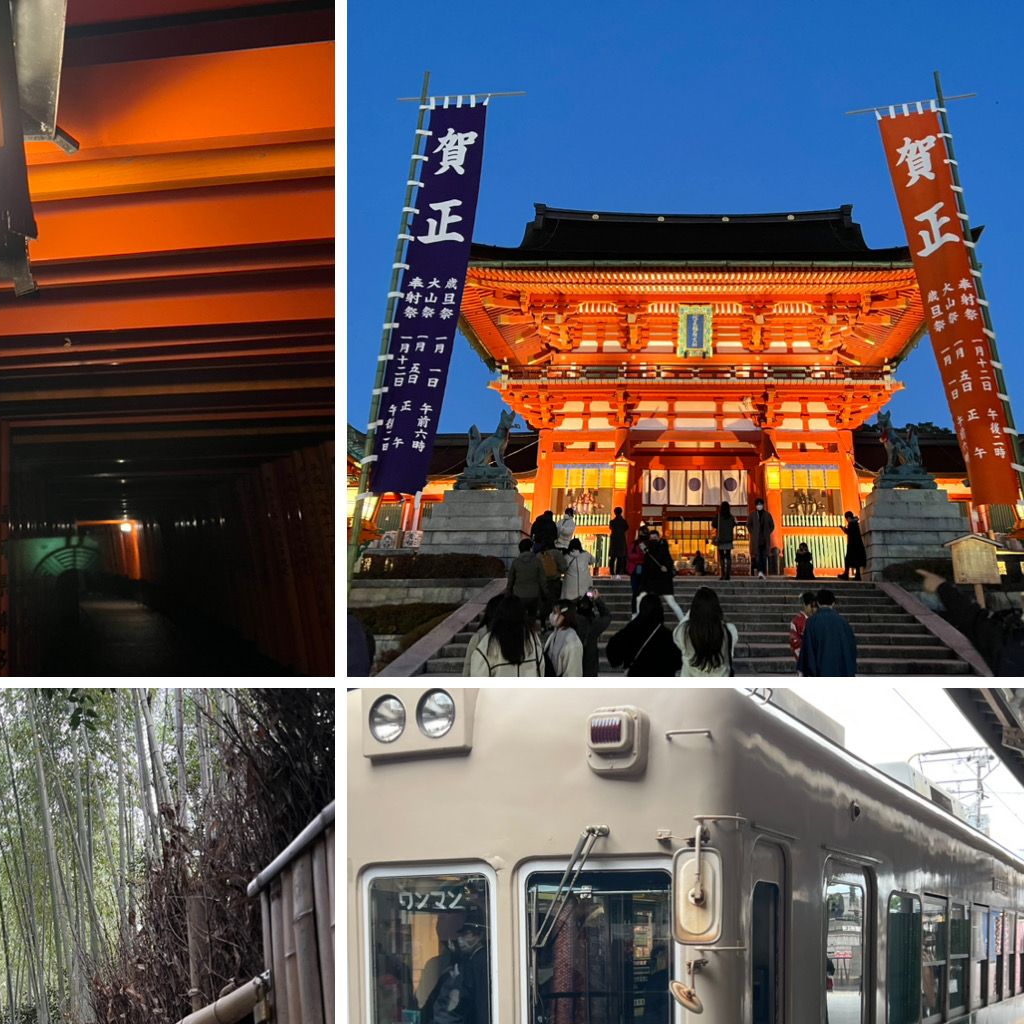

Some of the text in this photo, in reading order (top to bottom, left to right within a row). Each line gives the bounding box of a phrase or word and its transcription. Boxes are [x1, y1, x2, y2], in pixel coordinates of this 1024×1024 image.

[417, 127, 478, 245] 賀正
[895, 134, 960, 258] 賀正
[399, 891, 463, 910] ワンマン
